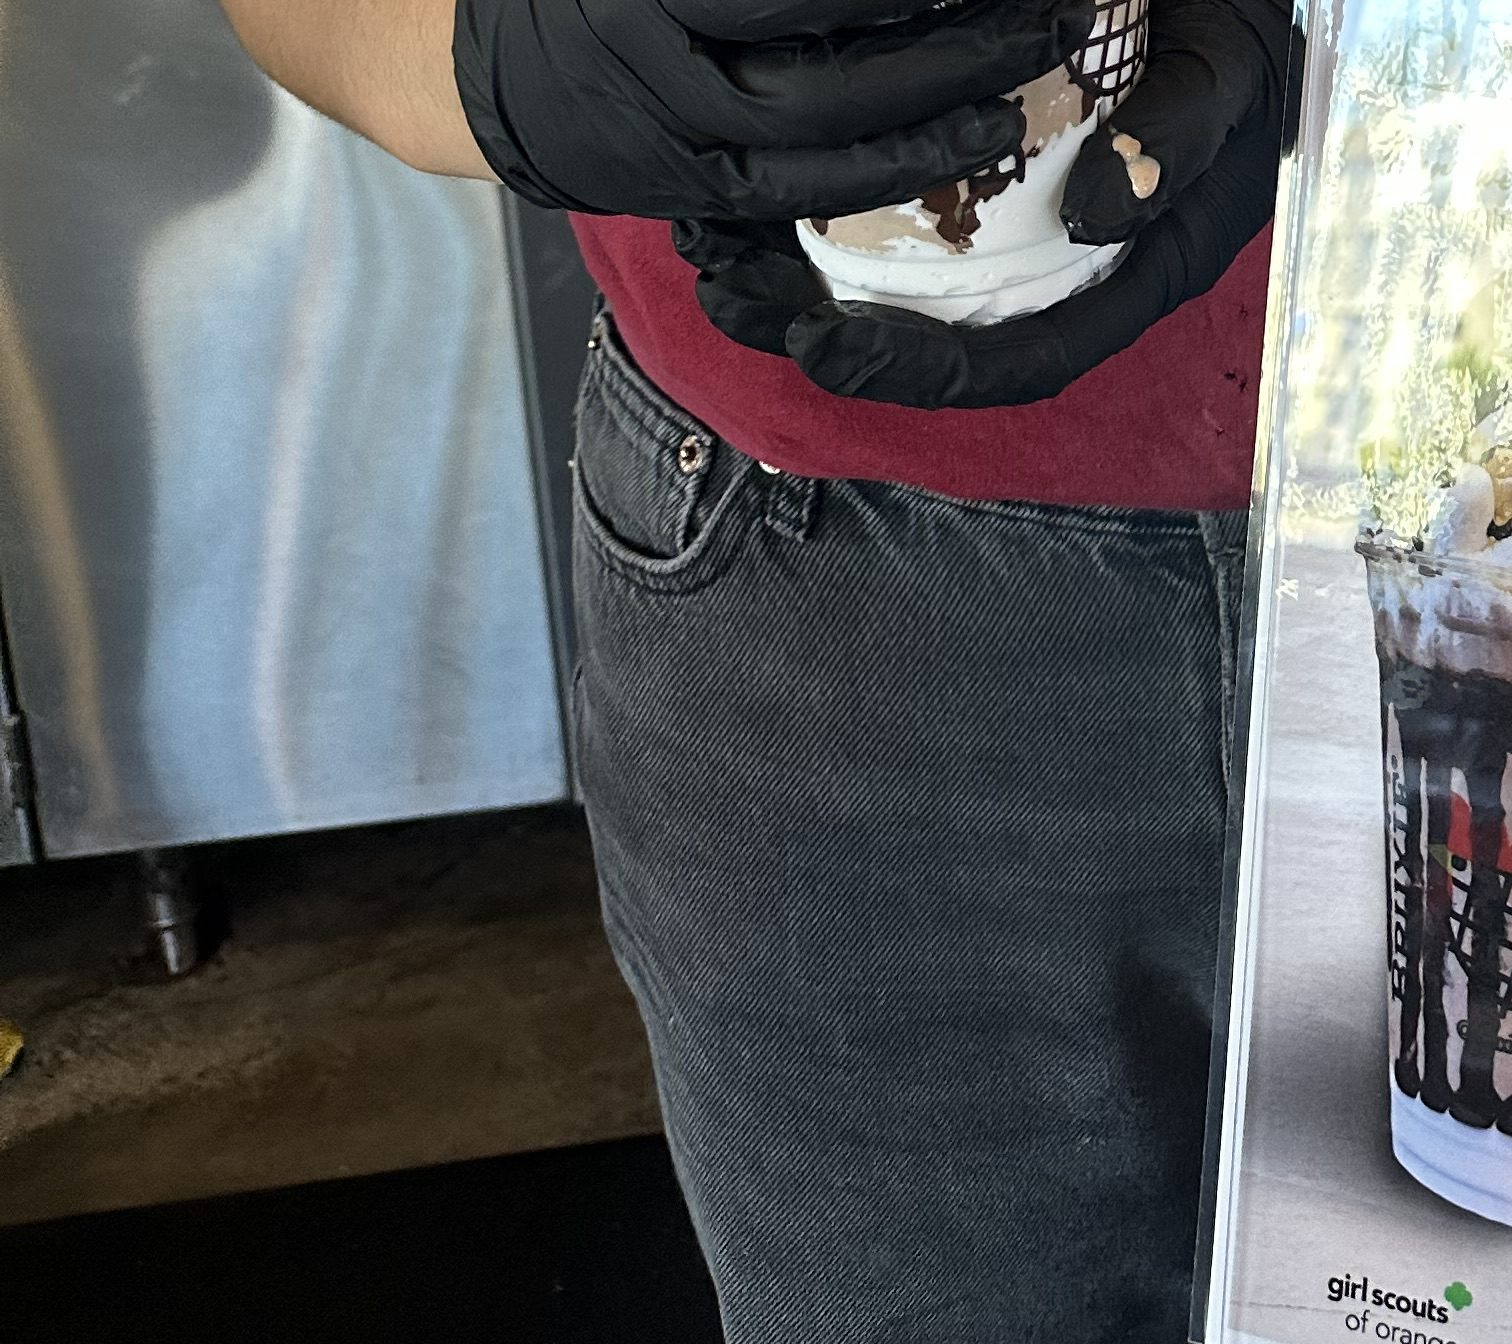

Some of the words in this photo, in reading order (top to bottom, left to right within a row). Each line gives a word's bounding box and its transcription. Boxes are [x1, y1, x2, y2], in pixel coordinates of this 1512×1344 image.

[1326, 1273, 1369, 1302] girl
[1371, 1284, 1449, 1324] scouts
[1345, 1309, 1370, 1334] of
[1375, 1322, 1457, 1344] oran
